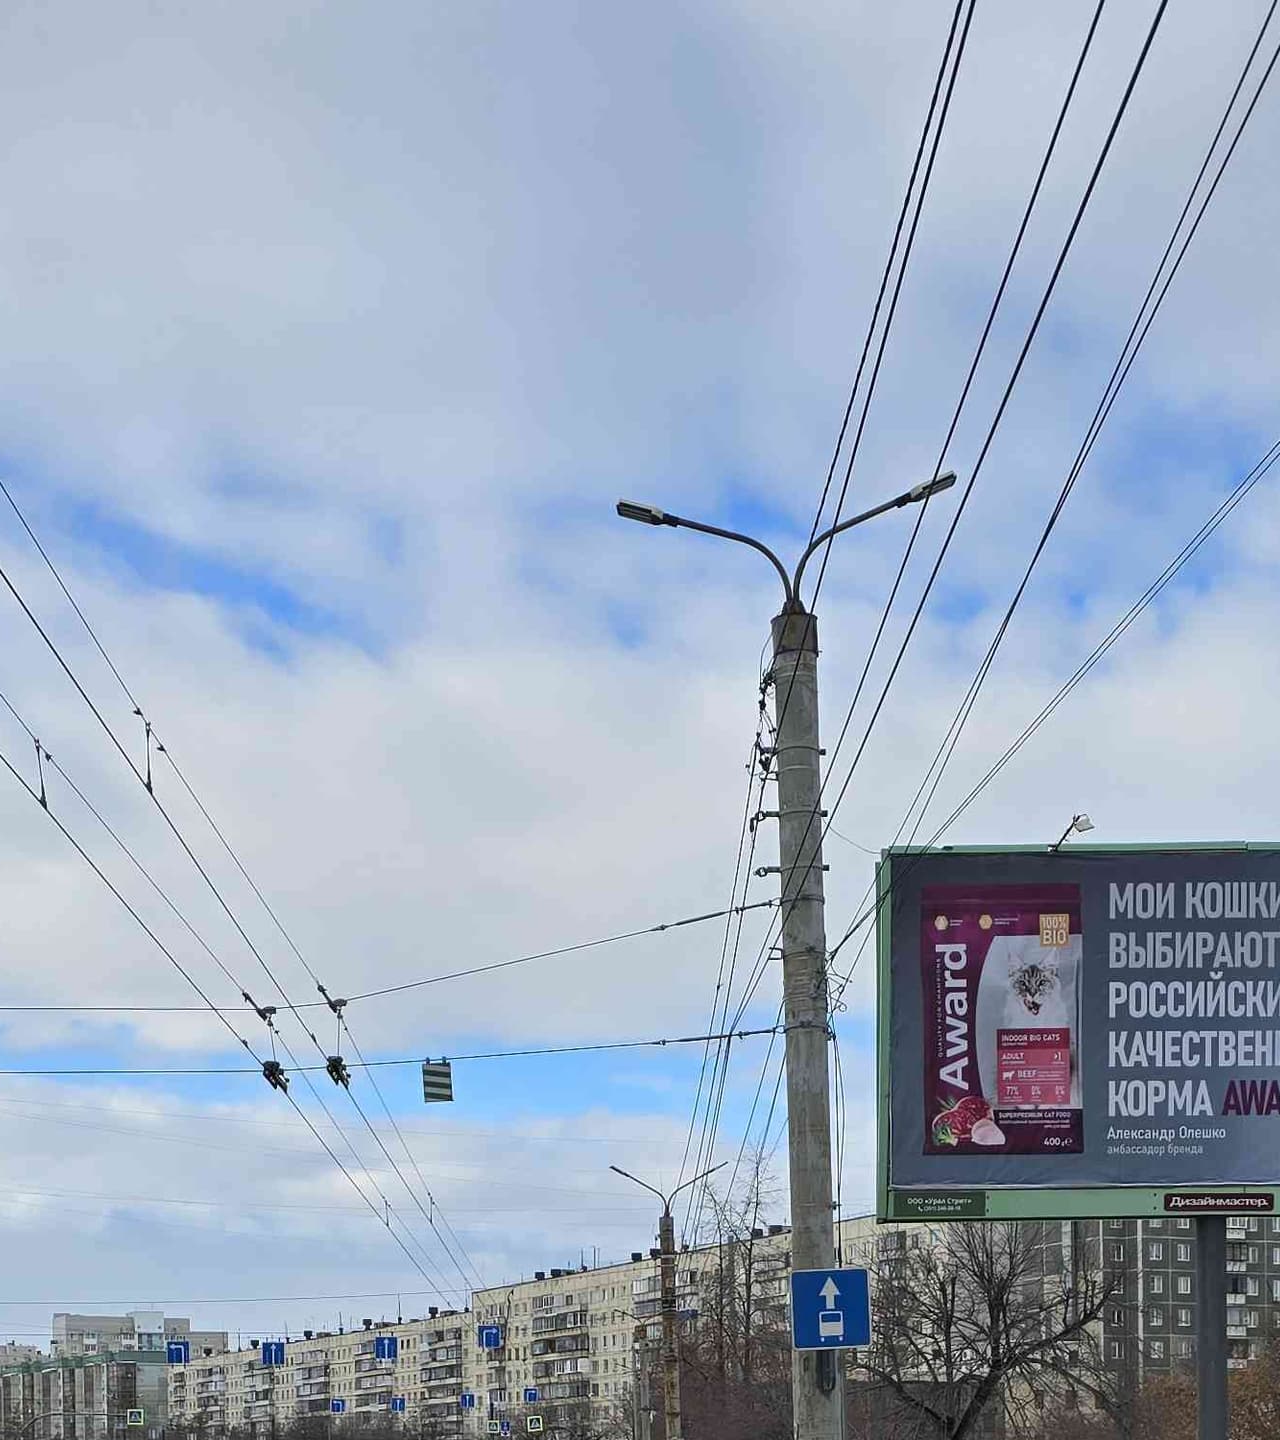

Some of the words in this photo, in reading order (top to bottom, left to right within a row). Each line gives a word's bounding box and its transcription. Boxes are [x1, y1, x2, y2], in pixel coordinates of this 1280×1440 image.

[1109, 883, 1175, 919] МОИ
[1042, 930, 1067, 945] BIO
[1109, 931, 1280, 968] ВЫБИРАЮТ
[935, 943, 970, 1091] Award
[1108, 1080, 1214, 1117] КОРМА
[1106, 1125, 1176, 1141] Александр
[1179, 1125, 1227, 1139] Олешко
[1106, 1144, 1166, 1156] амбассадор
[1167, 1143, 1203, 1156] бренда
